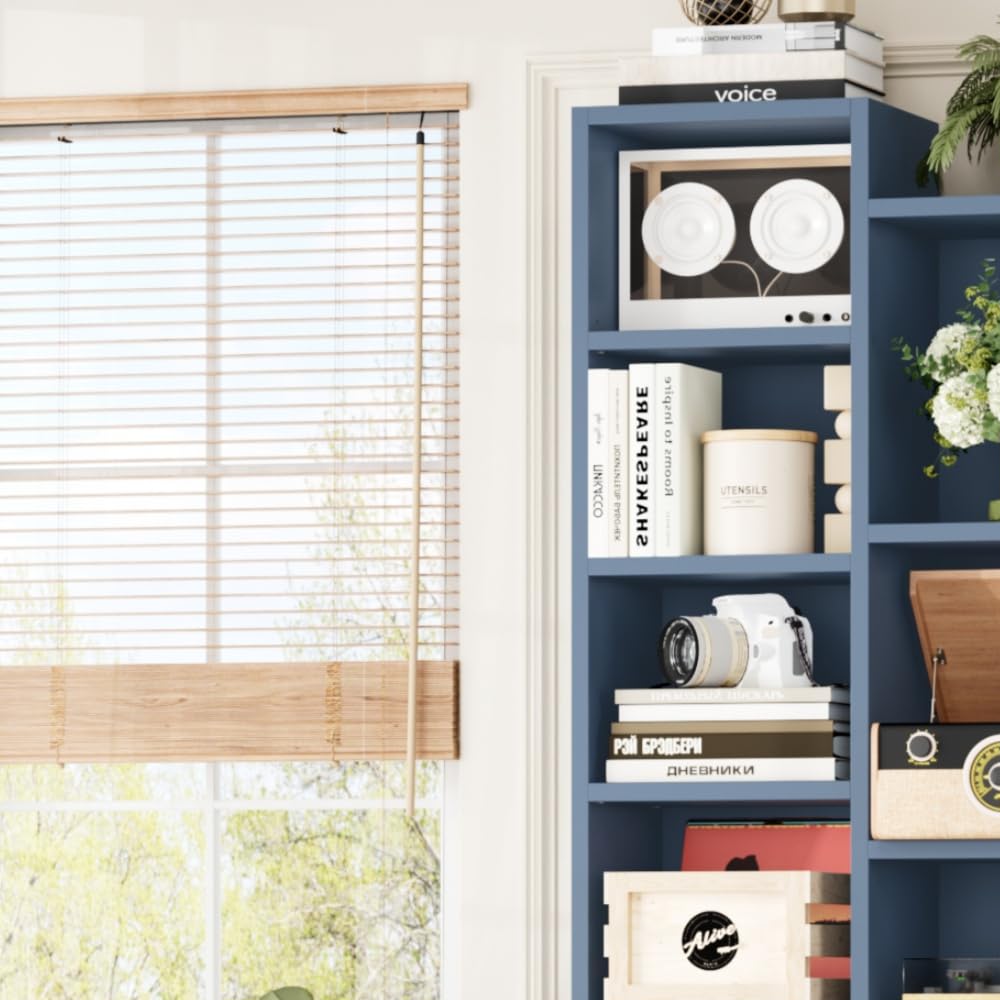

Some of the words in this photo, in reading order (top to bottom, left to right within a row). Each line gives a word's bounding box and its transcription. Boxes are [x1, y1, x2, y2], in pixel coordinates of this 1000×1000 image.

[675, 35, 730, 43] ARCHITTURE
[714, 84, 777, 102] voice
[720, 485, 768, 496] UTENSILS
[613, 734, 638, 755] РЭЙ
[642, 736, 703, 756] БРЭДБЕРИ
[666, 766, 755, 776] ДНЕВНИКИ
